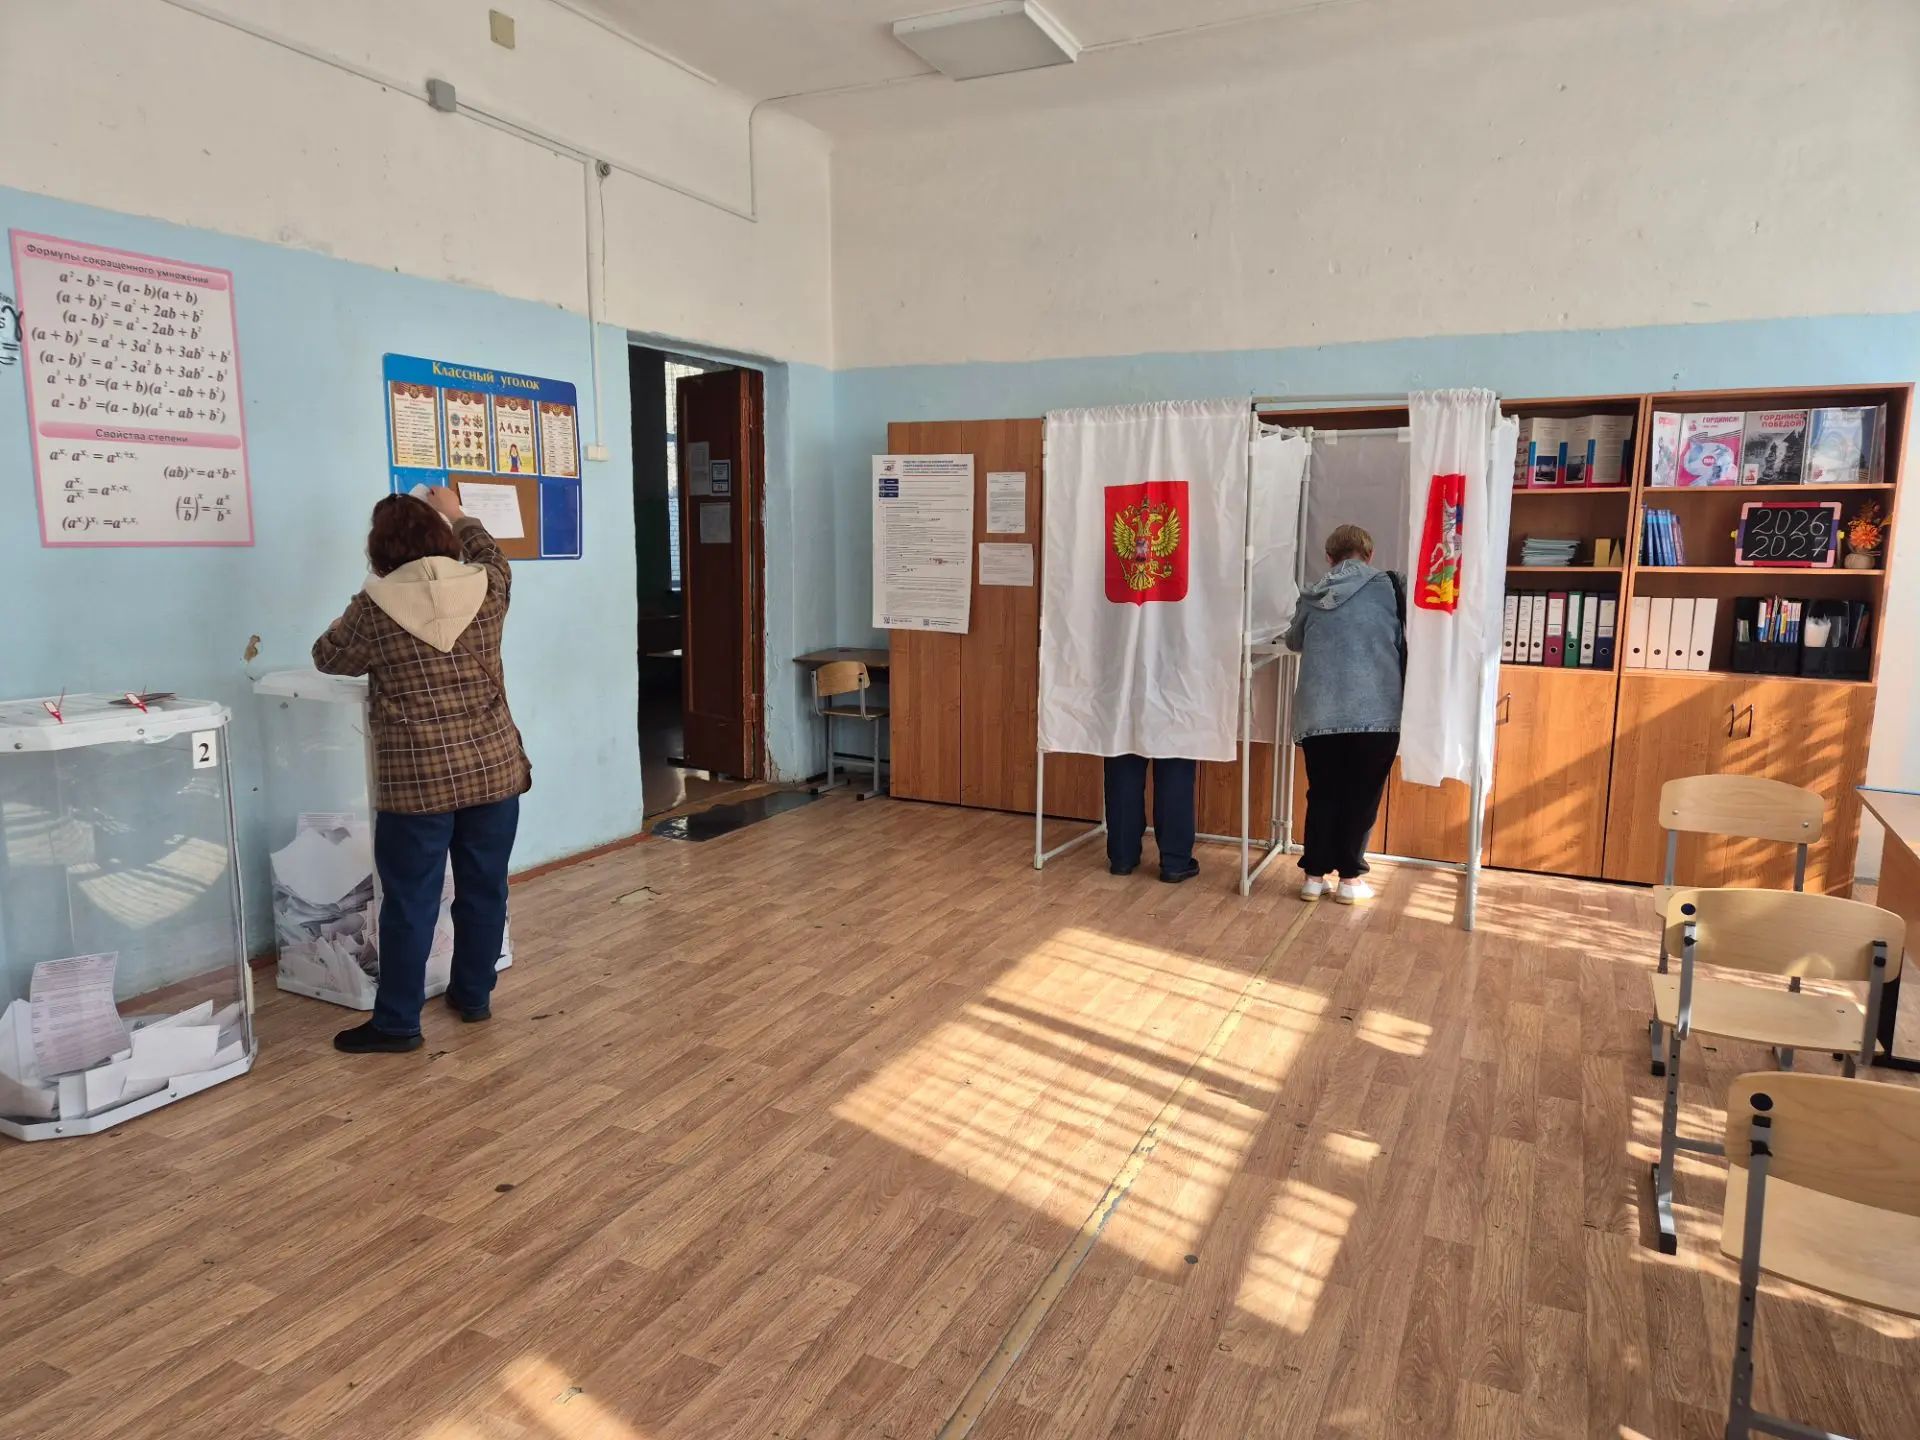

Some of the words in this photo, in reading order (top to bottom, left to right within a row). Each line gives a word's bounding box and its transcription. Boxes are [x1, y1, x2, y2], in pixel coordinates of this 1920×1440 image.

[27, 244, 80, 261] Формулы
[82, 256, 154, 274] сокращенного
[157, 269, 209, 283] умножения
[432, 361, 495, 383] Классный
[500, 375, 540, 390] уголок
[95, 428, 146, 441] Свойства
[148, 434, 188, 442] степени
[1747, 535, 1828, 558] 2027
[198, 742, 210, 762] 2
